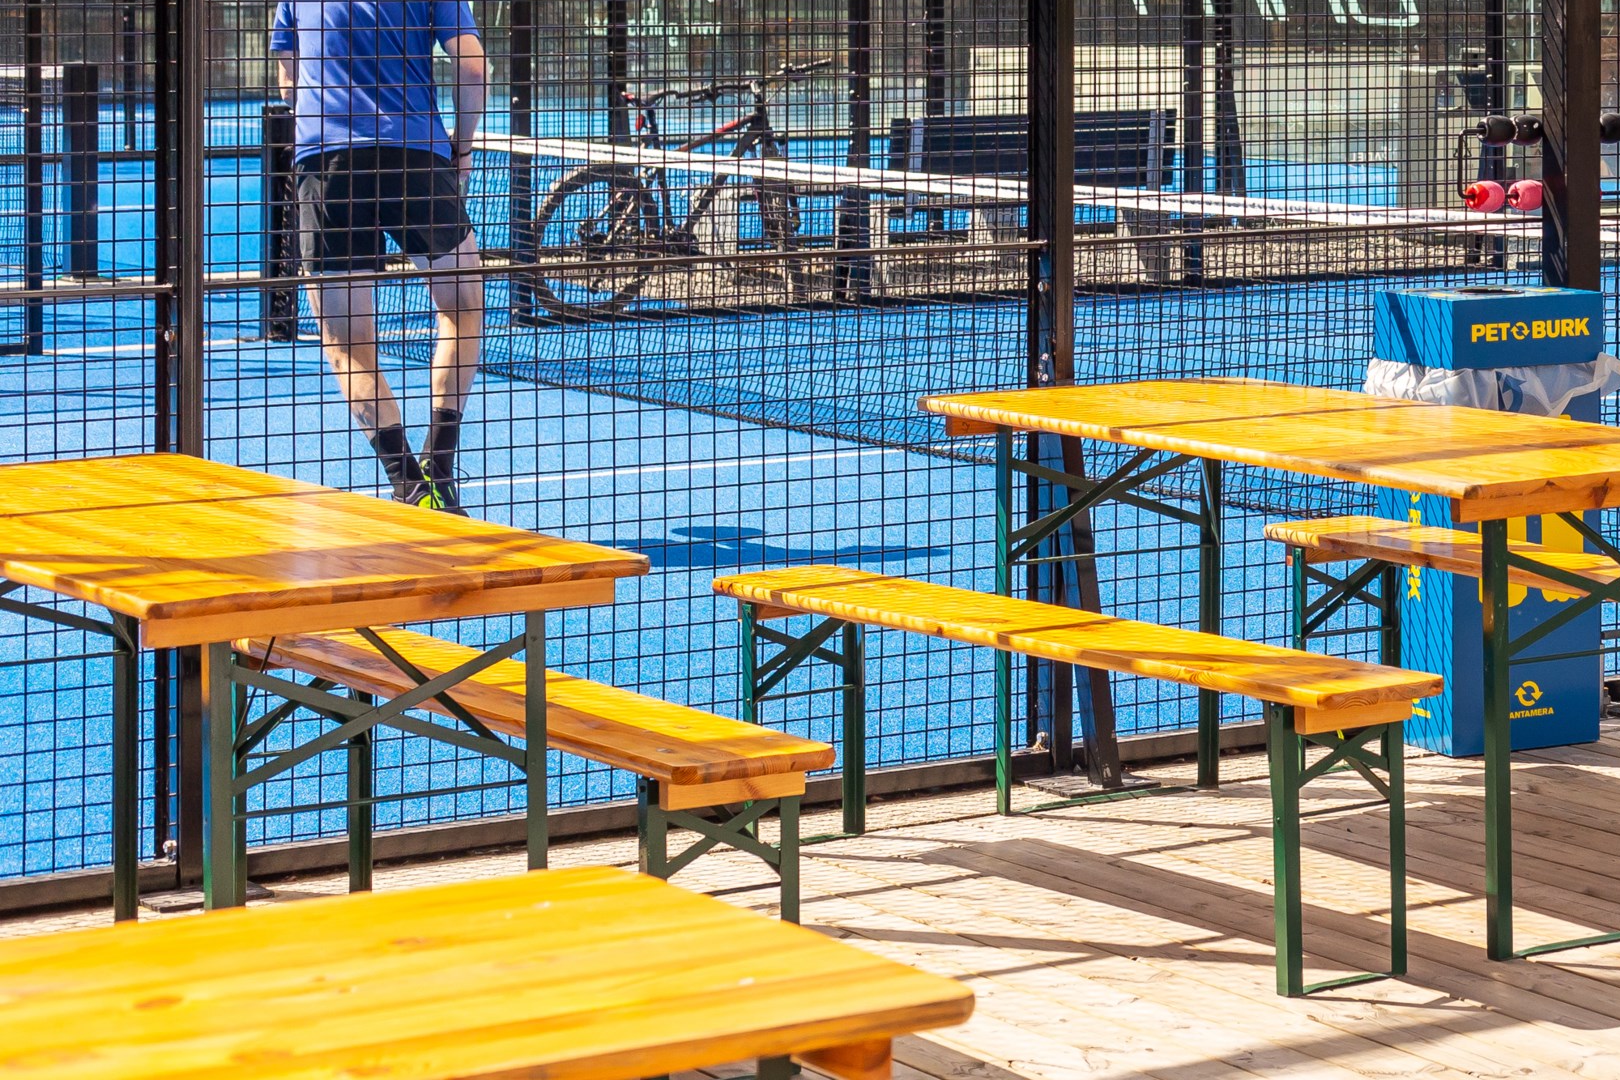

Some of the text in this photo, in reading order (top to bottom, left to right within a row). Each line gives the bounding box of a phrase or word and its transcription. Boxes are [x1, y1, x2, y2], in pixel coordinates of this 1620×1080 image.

[1471, 317, 1590, 343] PET BURK
[1508, 706, 1555, 720] ANTAMERA
